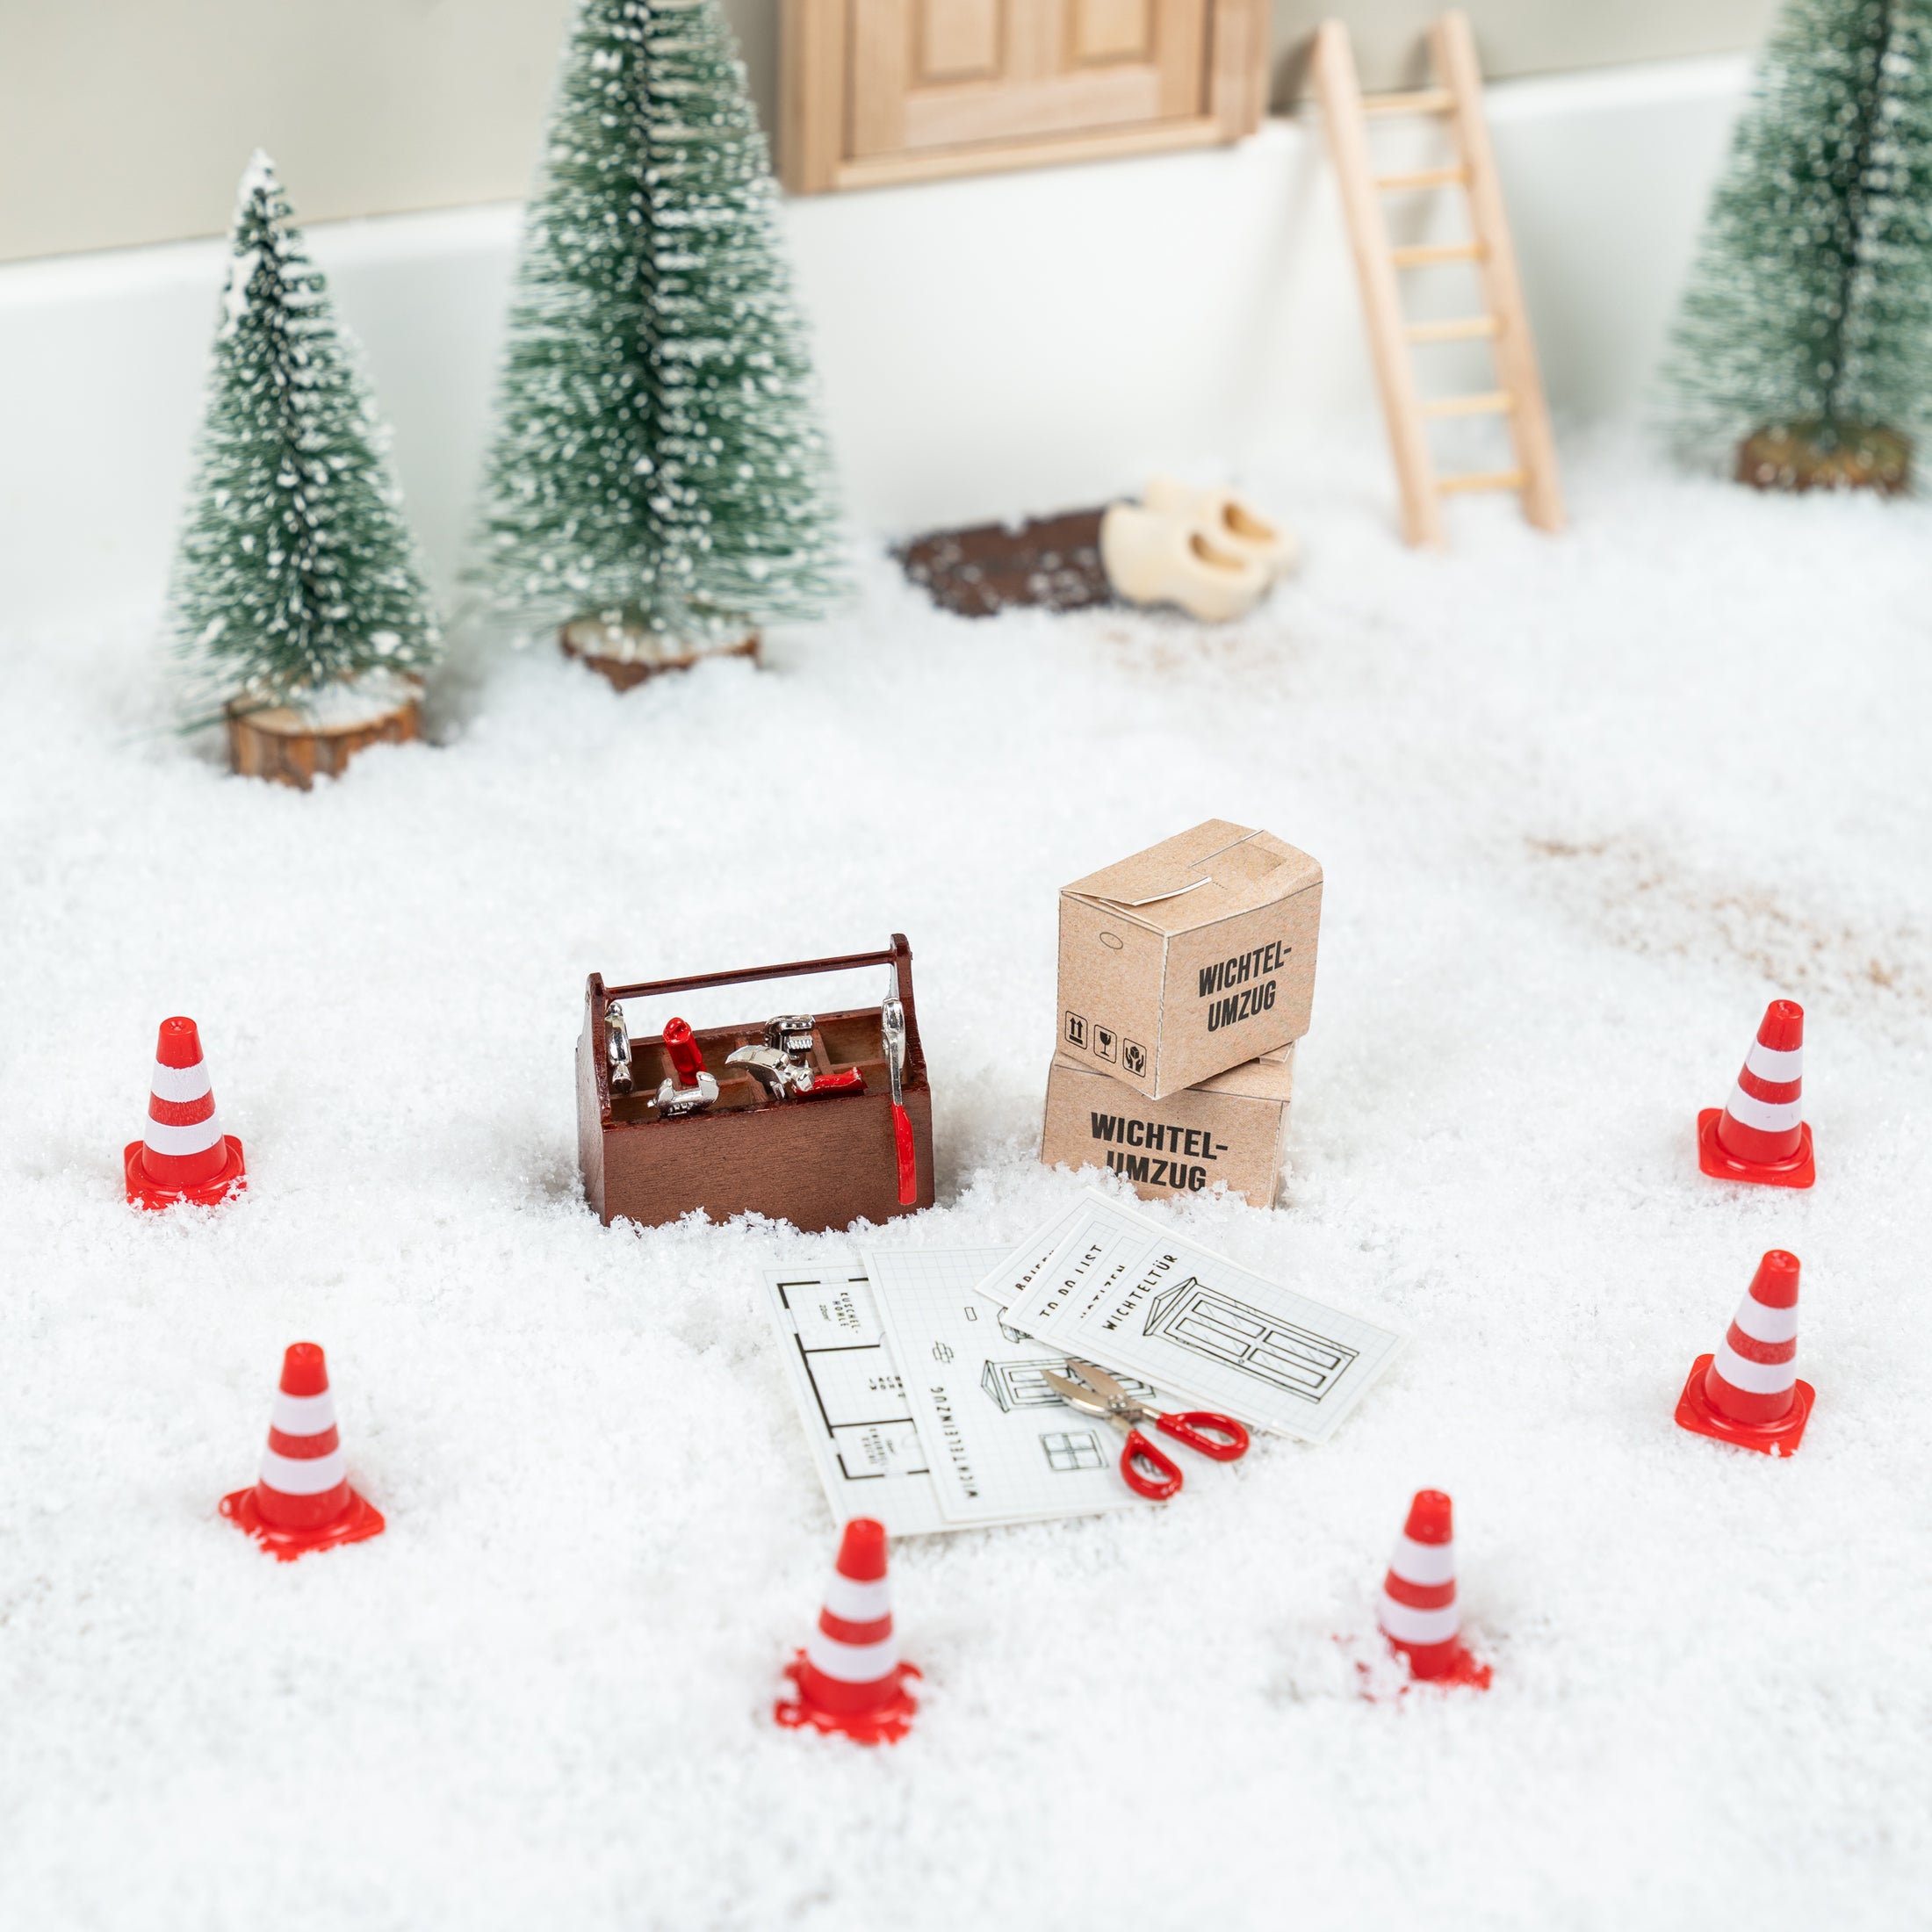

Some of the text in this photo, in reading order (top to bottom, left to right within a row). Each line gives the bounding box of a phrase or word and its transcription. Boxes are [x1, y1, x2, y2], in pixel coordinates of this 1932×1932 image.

[1198, 940, 1292, 998] WICHTEL-
[1207, 980, 1276, 1032] UMZUG
[1090, 1111, 1229, 1160] WICHTEL-
[1106, 1150, 1207, 1193] UMZUG
[1102, 1254, 1179, 1331] WICHTELTÜR
